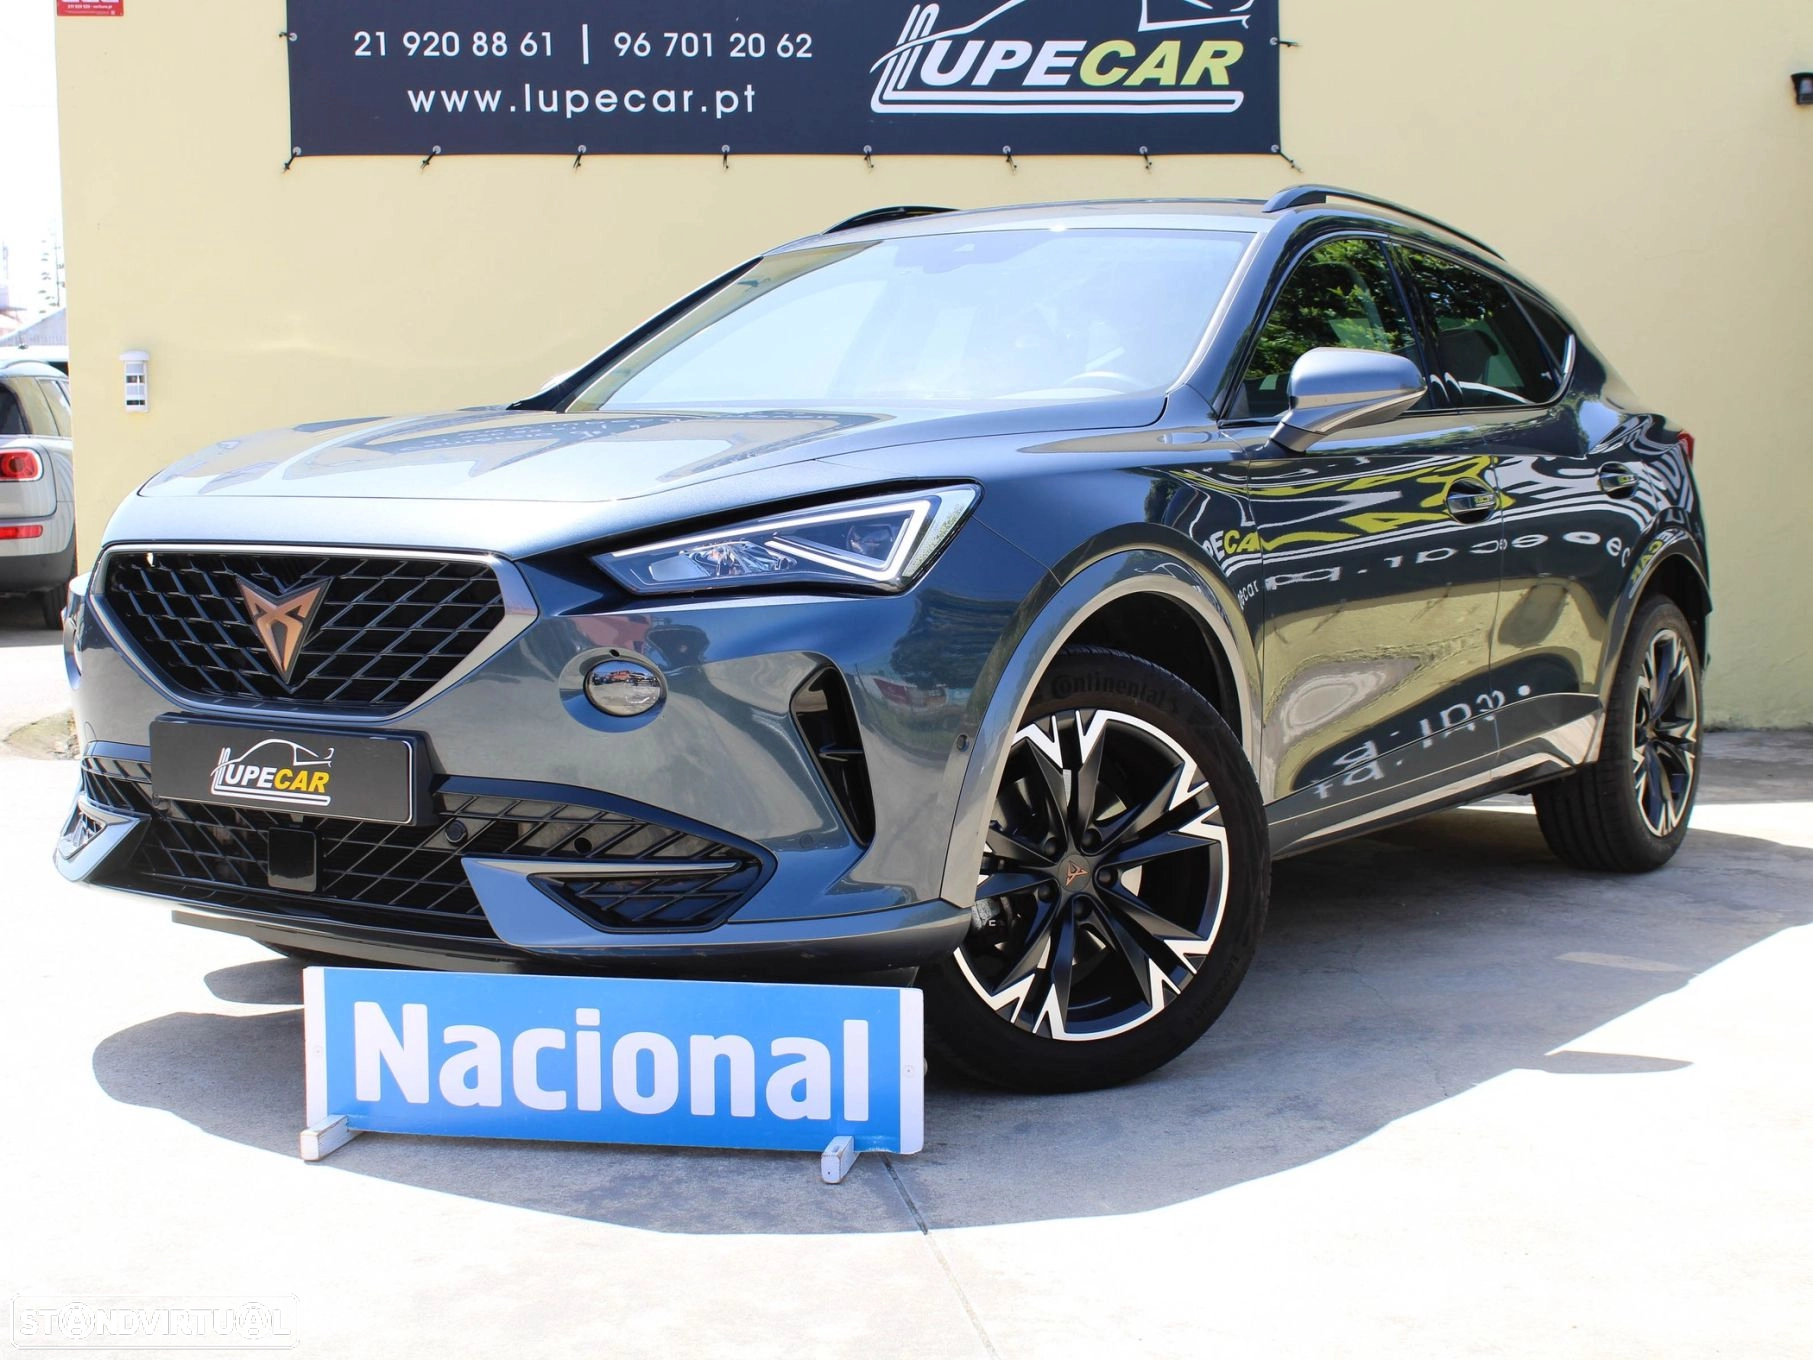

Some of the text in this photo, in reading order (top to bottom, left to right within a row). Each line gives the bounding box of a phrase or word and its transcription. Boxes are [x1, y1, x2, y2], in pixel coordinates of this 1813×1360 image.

[354, 31, 386, 56] 21
[402, 31, 460, 57] 920
[472, 31, 508, 57] 88
[520, 31, 552, 57] 61
[614, 31, 651, 57] 96
[663, 32, 713, 57] 701
[729, 32, 766, 58] 20
[776, 33, 812, 58] 62
[870, 4, 1244, 114] LUPECAR
[407, 83, 755, 119] www.lupecar.pt
[1050, 671, 1165, 708] Continental
[210, 747, 331, 806] LUPECAR
[353, 1000, 870, 1124] Nacional
